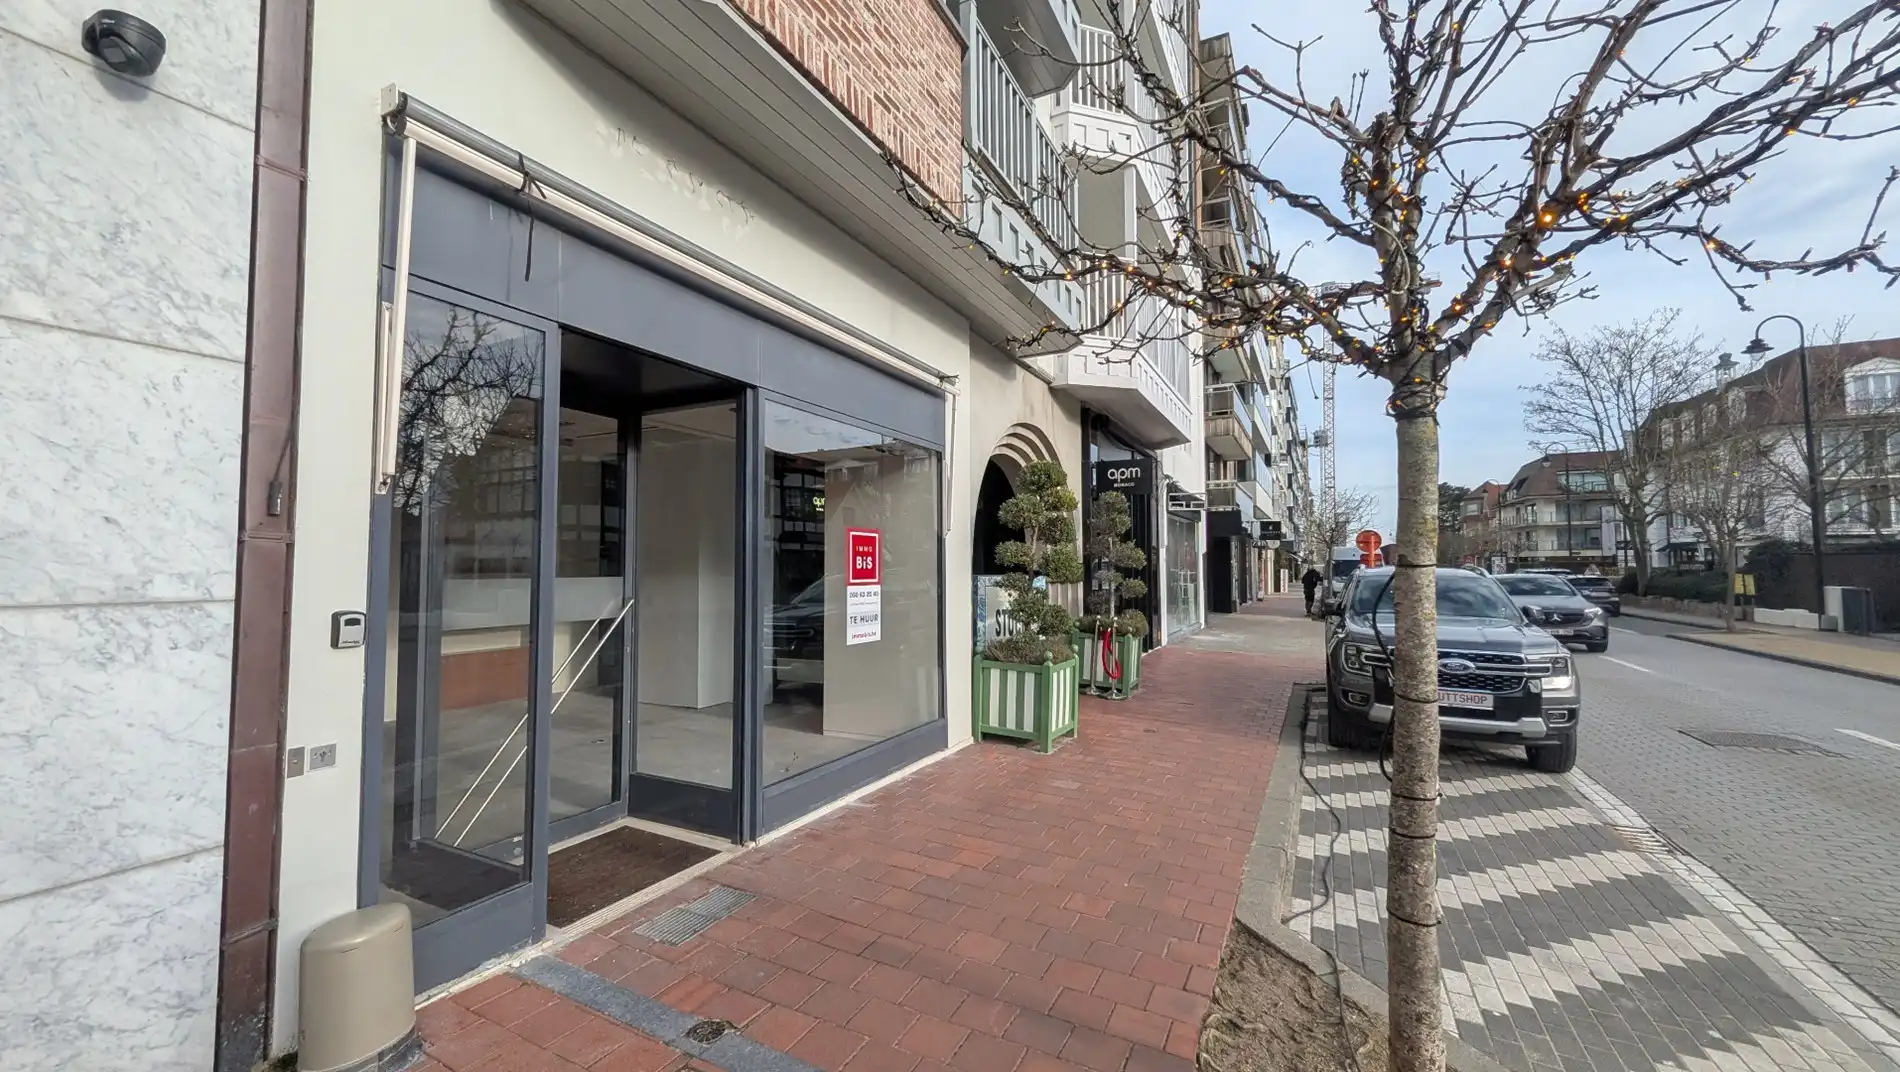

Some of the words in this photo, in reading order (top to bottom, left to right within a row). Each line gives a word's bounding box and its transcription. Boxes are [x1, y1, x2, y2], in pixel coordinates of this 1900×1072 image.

[1107, 467, 1141, 483] apm
[856, 556, 873, 569] BiS
[849, 616, 858, 625] TE
[859, 614, 879, 623] HUUR
